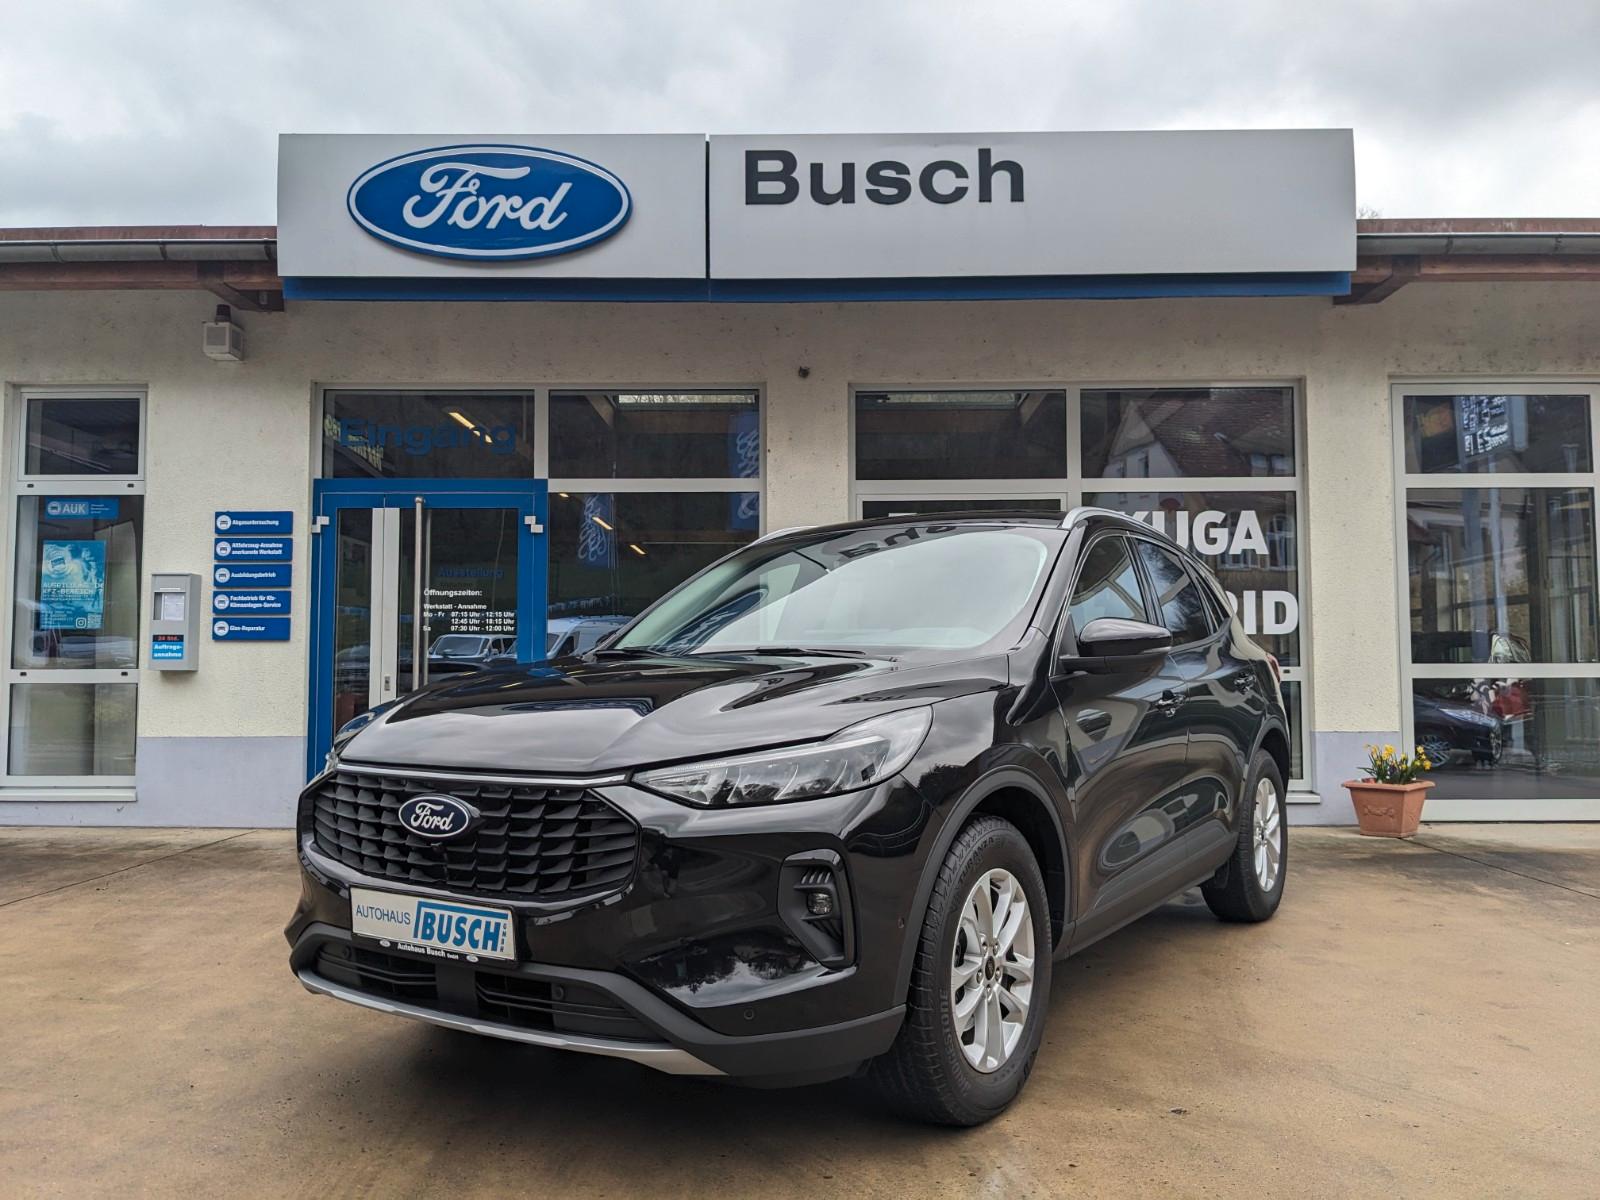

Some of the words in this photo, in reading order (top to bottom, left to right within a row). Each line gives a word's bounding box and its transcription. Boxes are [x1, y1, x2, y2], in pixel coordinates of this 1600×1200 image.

[744, 147, 1025, 206] Busch
[402, 162, 573, 231] Ford
[340, 416, 516, 456] Eingang
[62, 503, 87, 514] AUK
[423, 587, 483, 598] Öffnungszeiten:
[411, 801, 455, 831] Ford
[356, 904, 411, 925] AUTOHAUS
[420, 911, 502, 952] BUSCH
[397, 942, 426, 955] Autohaus
[426, 946, 447, 958] Busch
